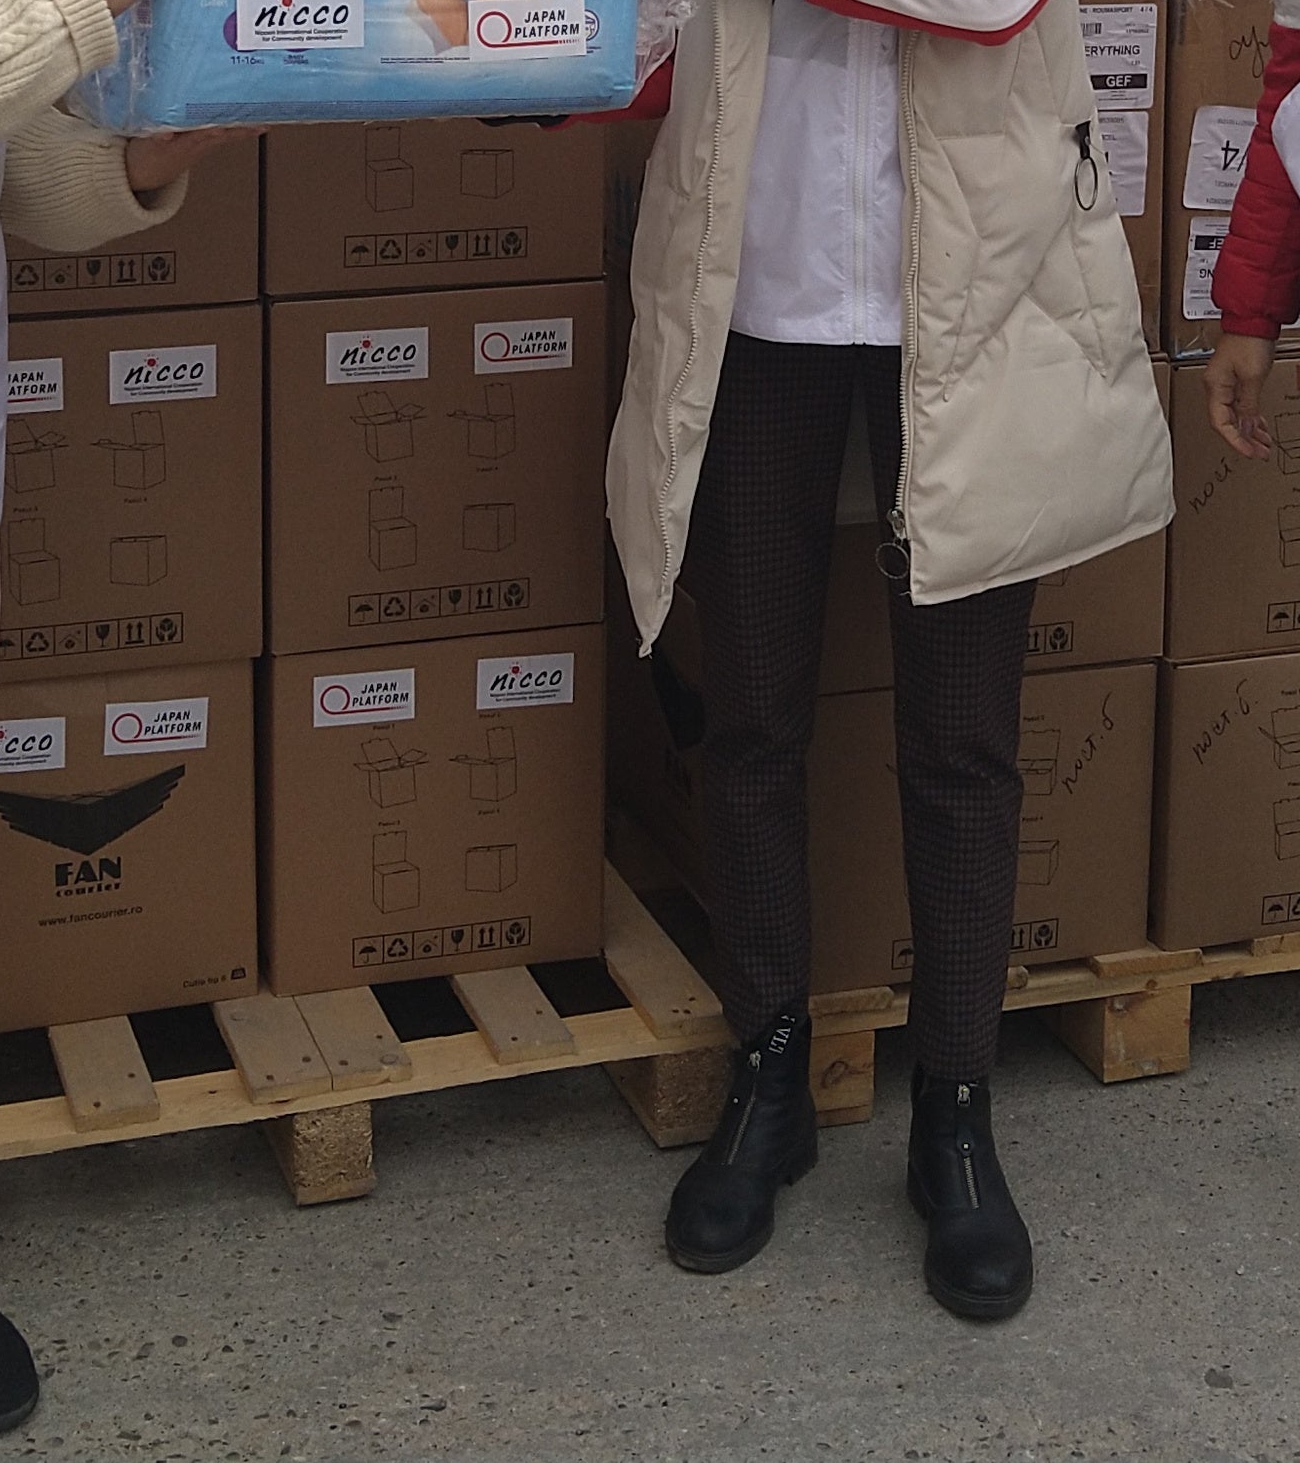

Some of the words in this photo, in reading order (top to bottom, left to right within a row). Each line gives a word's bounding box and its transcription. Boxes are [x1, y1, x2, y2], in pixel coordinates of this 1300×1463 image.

[525, 10, 566, 24] JAPAN
[514, 23, 580, 39] PLATFORM
[1085, 44, 1141, 57] ERYTHING
[1106, 75, 1132, 87] GEF
[1209, 238, 1225, 249] EF
[520, 331, 556, 342] JAPAN
[340, 340, 417, 365] nicco
[511, 341, 567, 355] PLATFORM
[123, 358, 204, 385] nicco
[8, 383, 57, 396] ATFORM
[490, 666, 562, 691] nicco
[361, 682, 398, 695] JAPAN
[352, 692, 409, 707] PLATFORM
[154, 710, 191, 723] JAPAN
[144, 721, 202, 736] PLATFORM
[55, 856, 122, 887] FAN
[56, 881, 122, 898] courier
[38, 905, 143, 927] www.fancourier.ro
